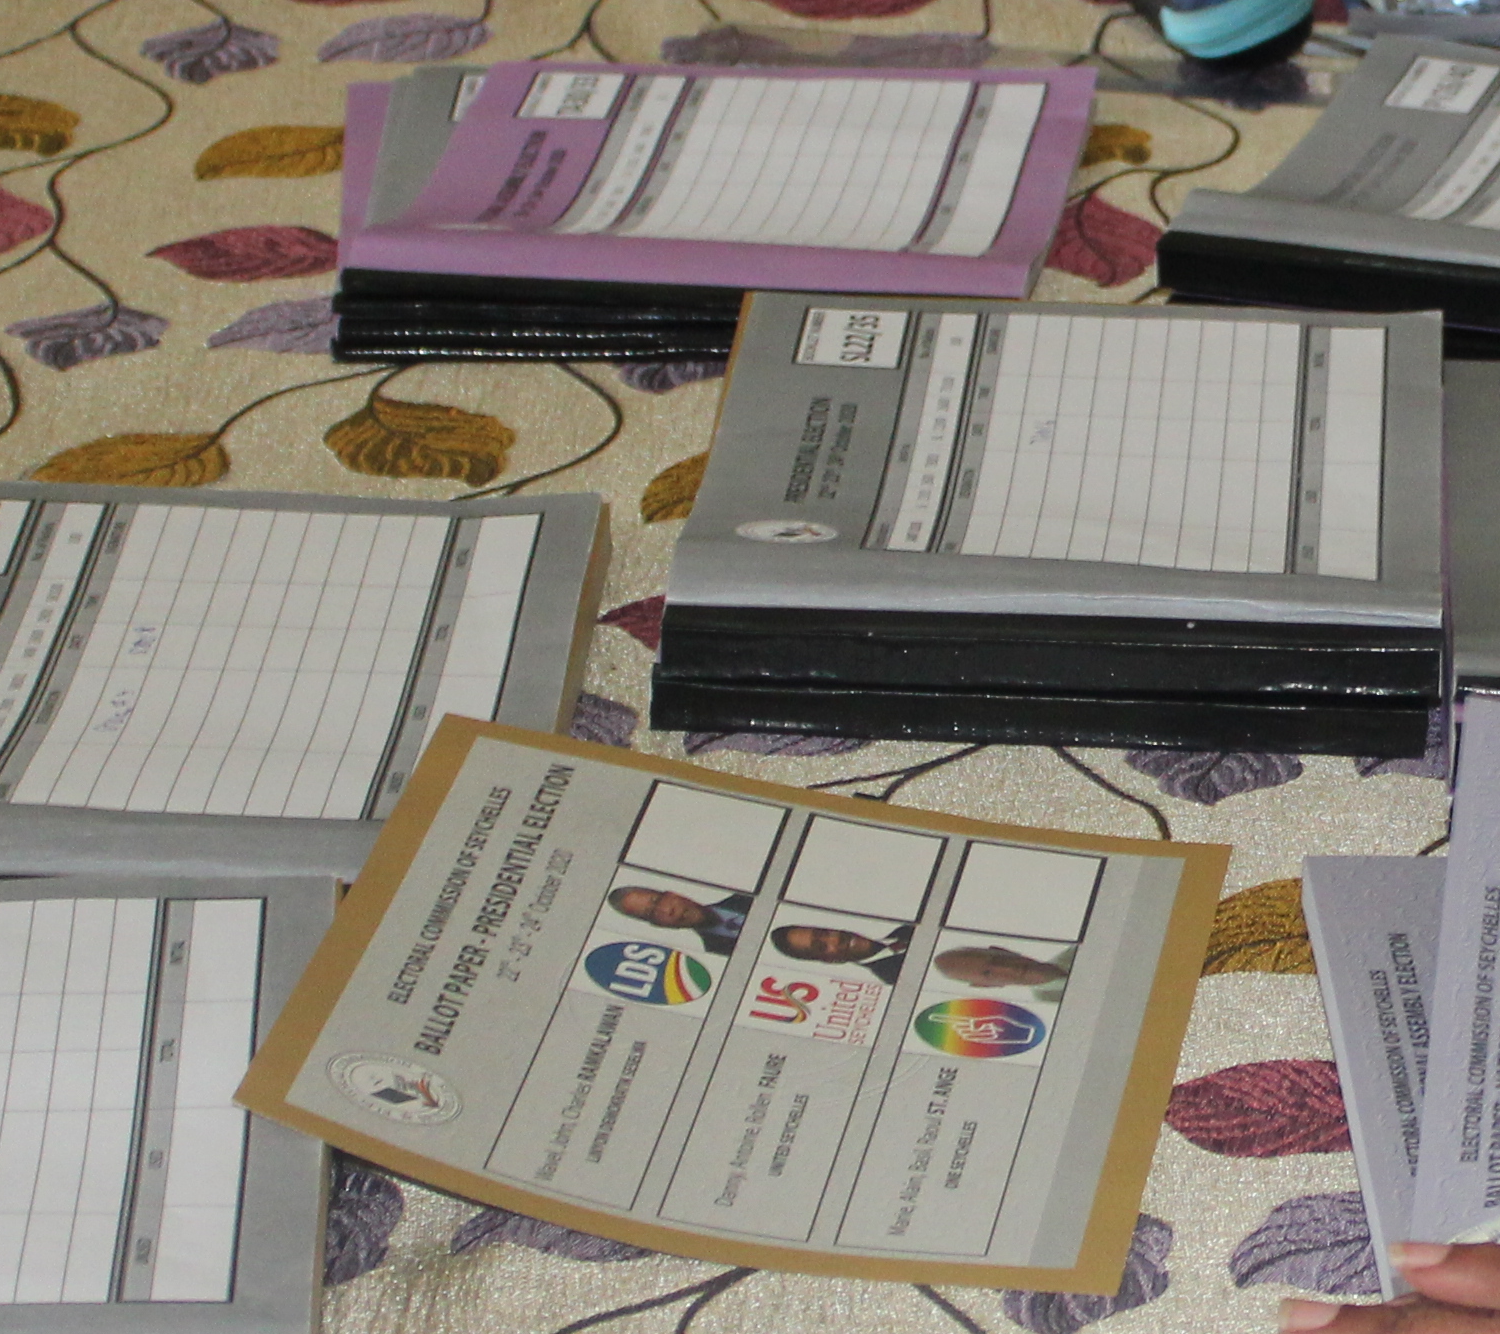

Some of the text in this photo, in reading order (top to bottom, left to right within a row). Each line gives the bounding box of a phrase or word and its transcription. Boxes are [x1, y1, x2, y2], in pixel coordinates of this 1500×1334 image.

[783, 397, 832, 503] PRESIDENTIAL ELECTION
[386, 785, 512, 1004] ELECTORAL COMMISSION OF SEYCHELLES
[413, 993, 466, 1055] BALLOT
[444, 944, 489, 993] PAPER
[472, 831, 547, 937] PRESIDENTIAL
[521, 764, 575, 830] ELECTION
[531, 849, 574, 912] October 2020
[609, 943, 666, 998] LDS
[1369, 970, 1397, 1028] SEYCHELLES
[1387, 932, 1429, 1049] ASSEMBLY ELECTION
[1476, 973, 1494, 993] OF
[813, 978, 864, 1040] United
[850, 983, 881, 1045] SEYCHELLES
[1383, 1029, 1400, 1044] OF
[1467, 994, 1492, 1085] COMMISSION
[570, 1004, 625, 1082] RAMKALAWAN
[558, 1083, 592, 1119] Charles
[926, 1099, 948, 1116] ST.
[935, 1067, 958, 1098] ANGE
[1386, 1045, 1417, 1115] COMMISSION
[713, 1172, 746, 1207] Danny,
[757, 1054, 788, 1089] FAURE
[767, 1094, 809, 1176] UNITED SEYCHELLES
[943, 1121, 978, 1189] ONE SEYCHELLES
[1459, 1088, 1485, 1163] ELECTORAL
[887, 1206, 916, 1236] Marie,
